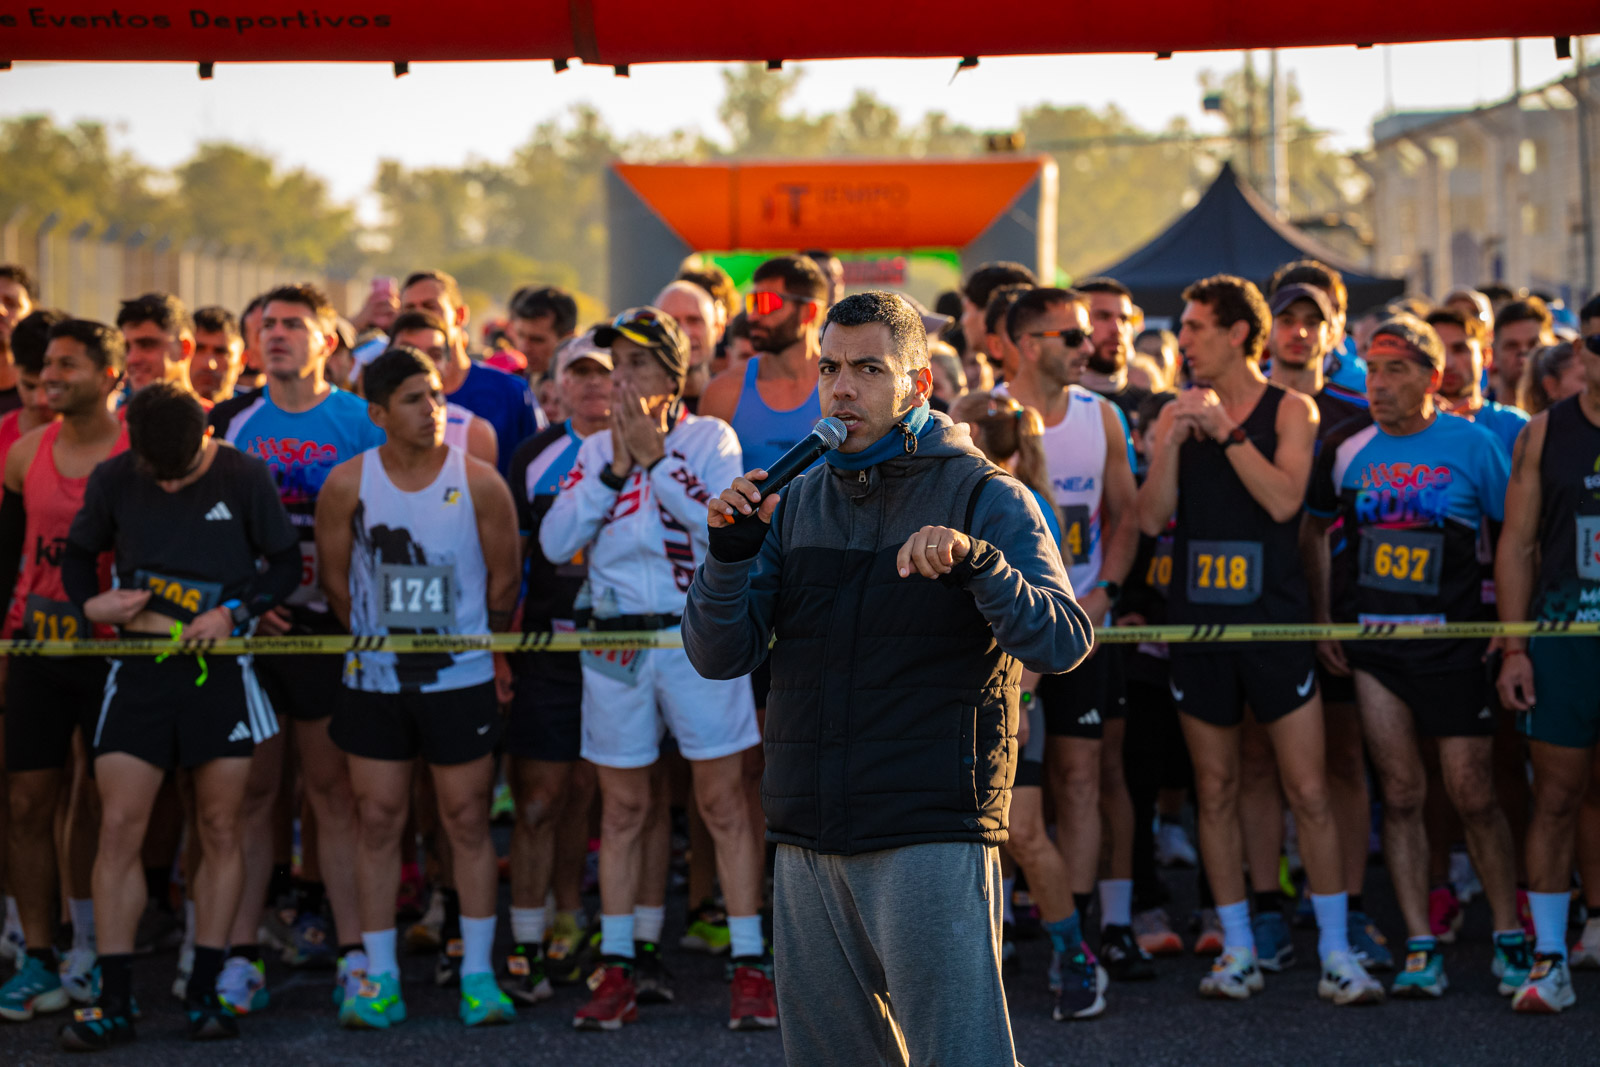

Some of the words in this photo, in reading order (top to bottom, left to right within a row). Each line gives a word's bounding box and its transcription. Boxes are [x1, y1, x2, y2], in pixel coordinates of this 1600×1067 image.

[28, 7, 171, 29] Eventos
[190, 9, 391, 36] Deportivos
[1198, 553, 1248, 590] 718
[1375, 543, 1430, 582] 637
[390, 576, 443, 613] 174
[33, 610, 79, 643] 712
